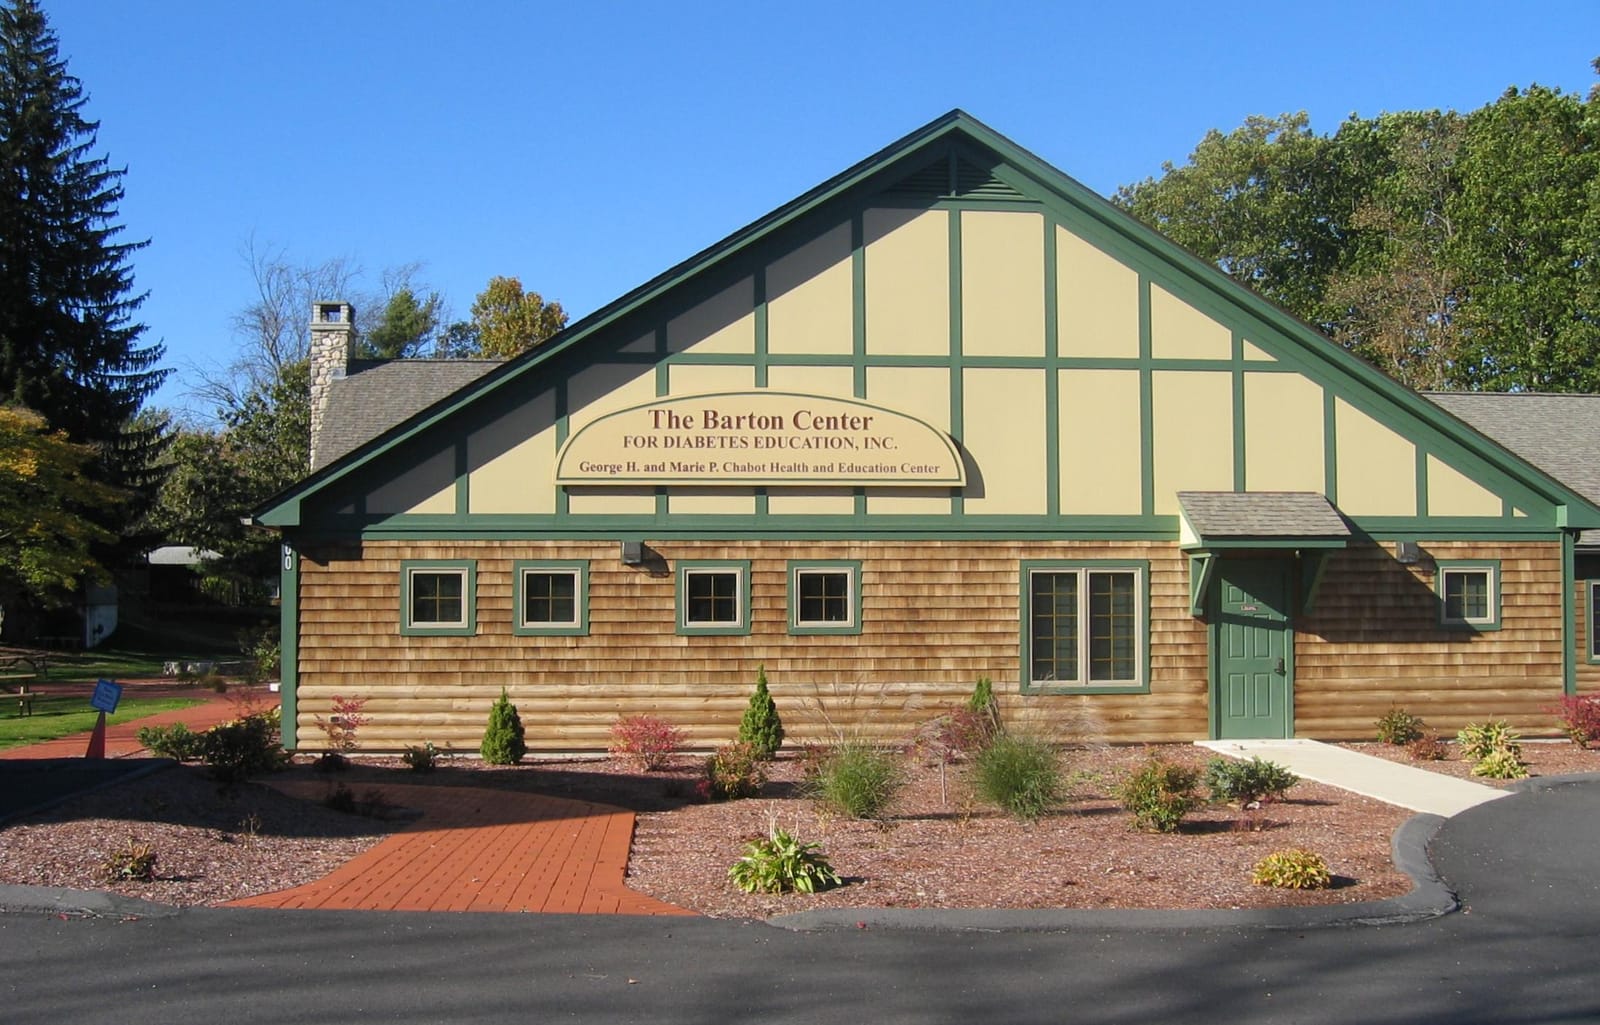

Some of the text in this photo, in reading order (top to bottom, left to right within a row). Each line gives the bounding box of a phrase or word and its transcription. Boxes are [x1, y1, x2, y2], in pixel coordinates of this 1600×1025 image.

[648, 409, 874, 431] The Barton Center
[623, 435, 898, 451] FOR DIABETES EDUCATION, INC.
[579, 461, 941, 475] George H. and Marie P. Chabot Health and Education Center
